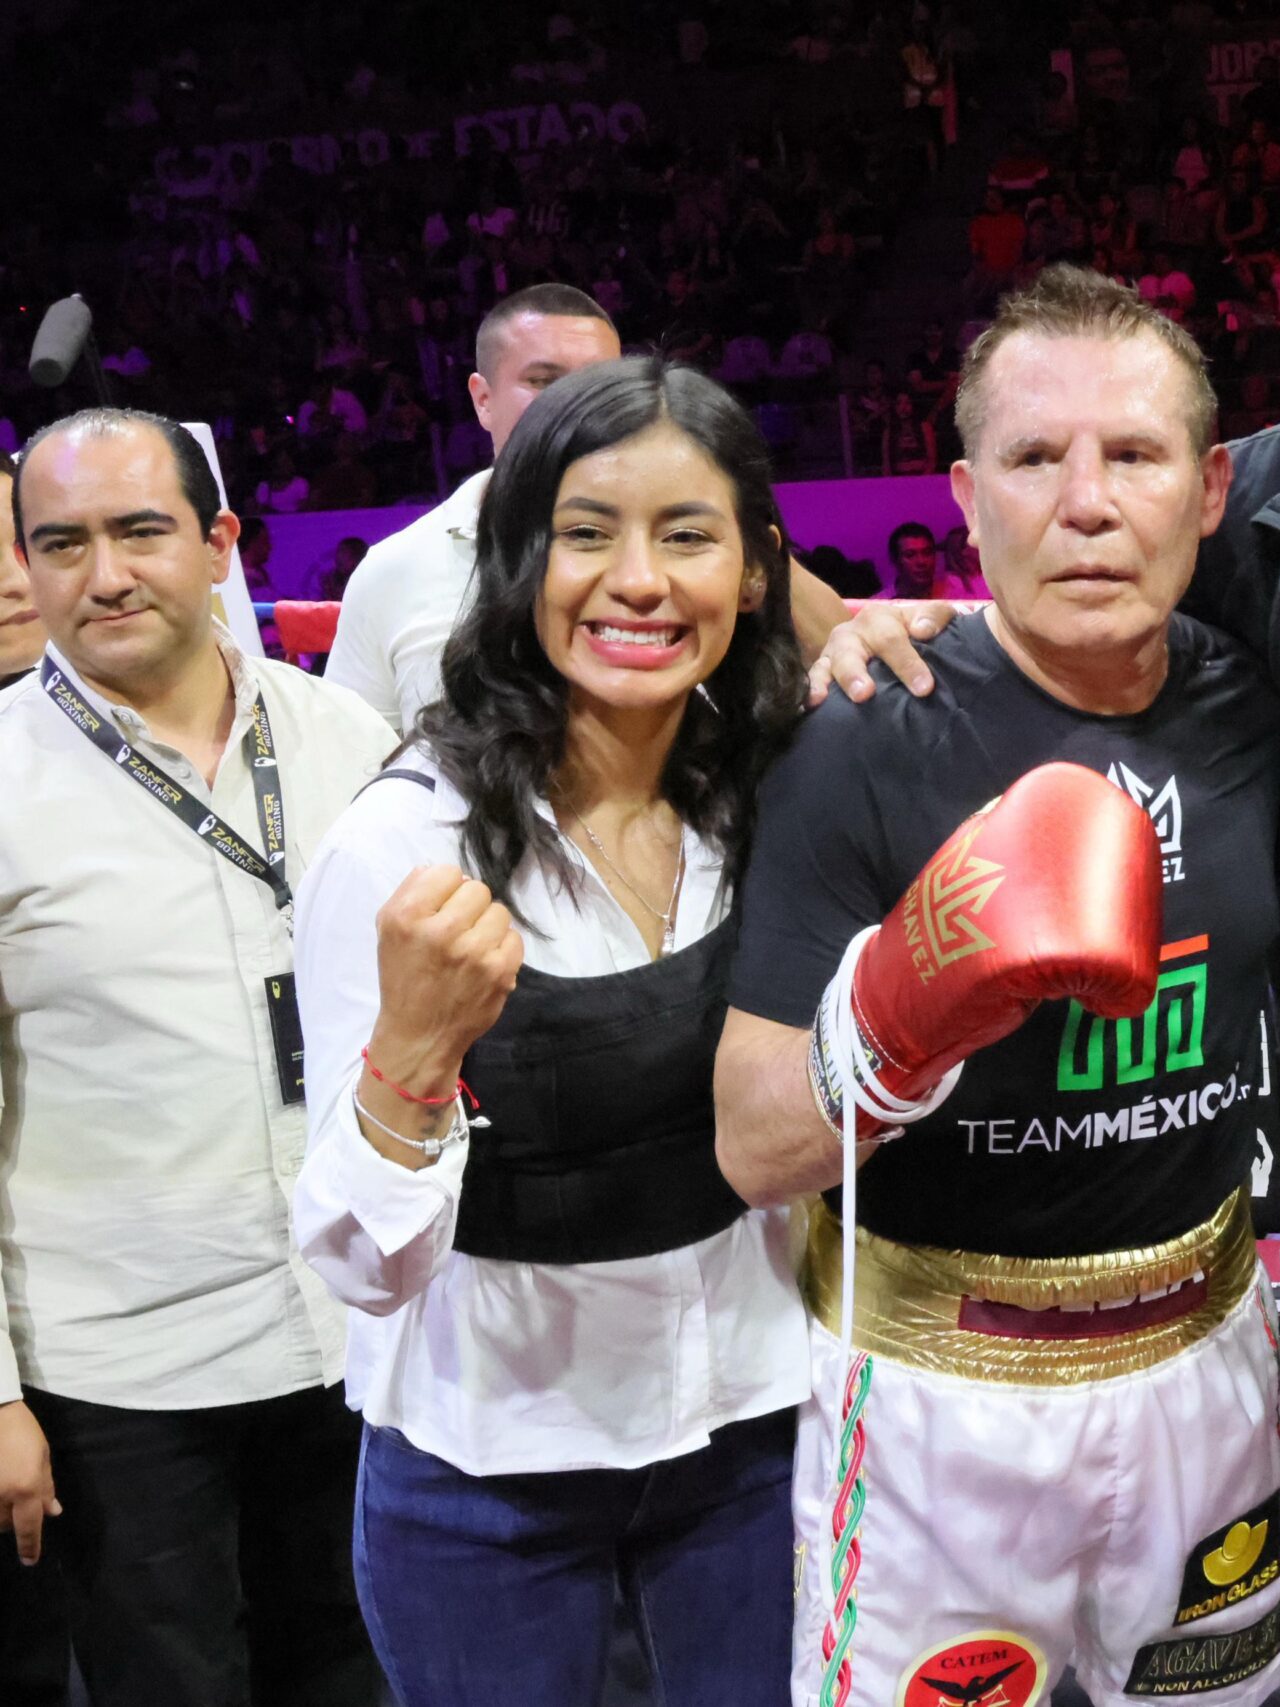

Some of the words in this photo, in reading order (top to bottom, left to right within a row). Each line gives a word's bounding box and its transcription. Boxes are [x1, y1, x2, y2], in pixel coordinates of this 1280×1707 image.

[55, 683, 100, 732] ZANFER
[57, 697, 88, 730] BOXING
[129, 757, 182, 804] ZANFER
[133, 769, 169, 801] BOXING
[264, 793, 279, 851] ZANFER
[273, 800, 282, 839] BOXING
[211, 827, 266, 874] ZANFER
[904, 879, 937, 986] CHAVEZ
[940, 1649, 1008, 1670] CATEM
